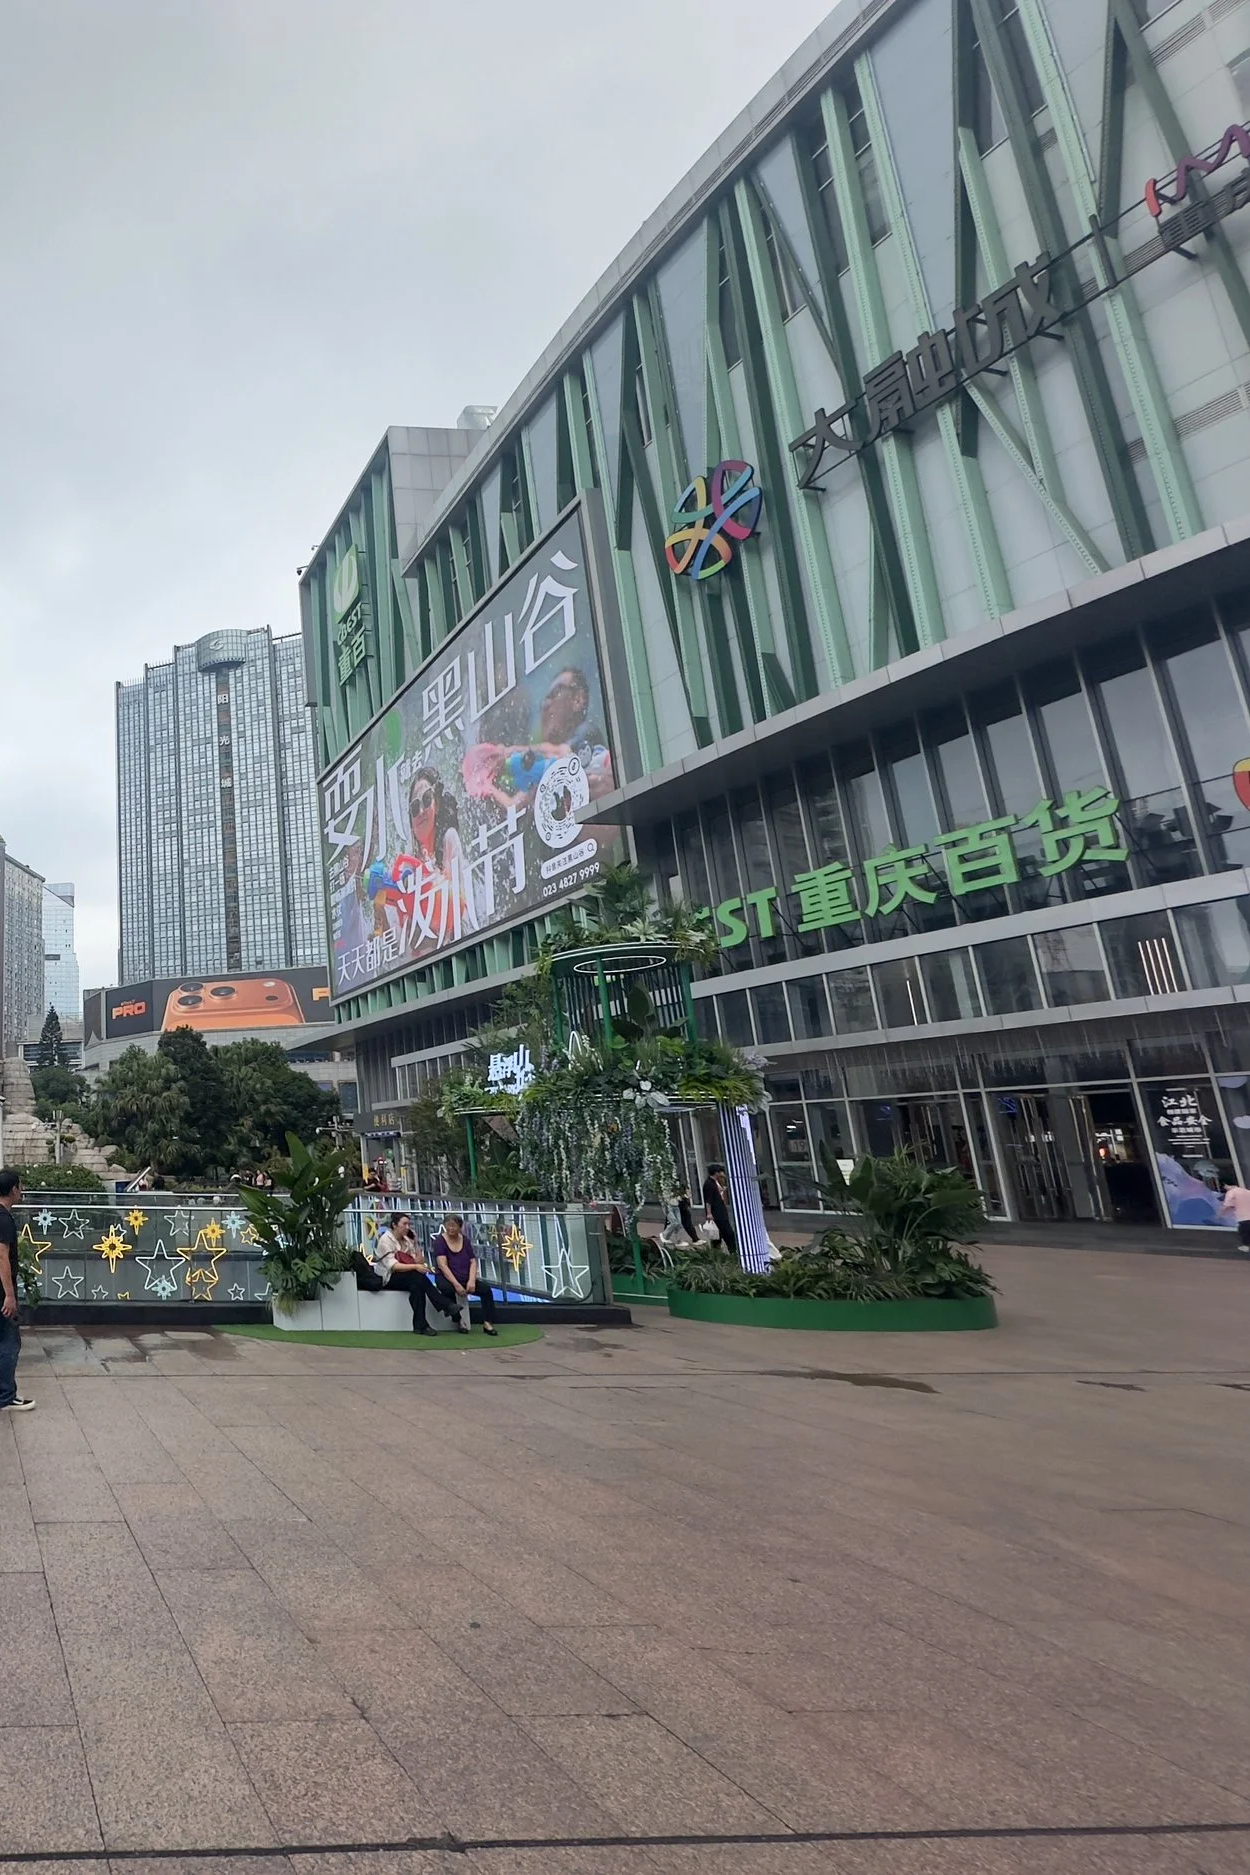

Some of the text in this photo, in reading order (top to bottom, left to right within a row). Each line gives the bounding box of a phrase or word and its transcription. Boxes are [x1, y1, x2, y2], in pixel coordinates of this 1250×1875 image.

[789, 255, 1061, 489] 大融城
[338, 625, 366, 687] 重百
[322, 743, 409, 873] 耍水
[421, 550, 579, 762] 黑山谷
[337, 805, 527, 986] 天天都是 泼水节
[543, 862, 600, 897] 023 4827 9999
[791, 785, 1130, 933] 重庆百货
[111, 1001, 146, 1020] PRO
[1161, 1094, 1198, 1108] 江北
